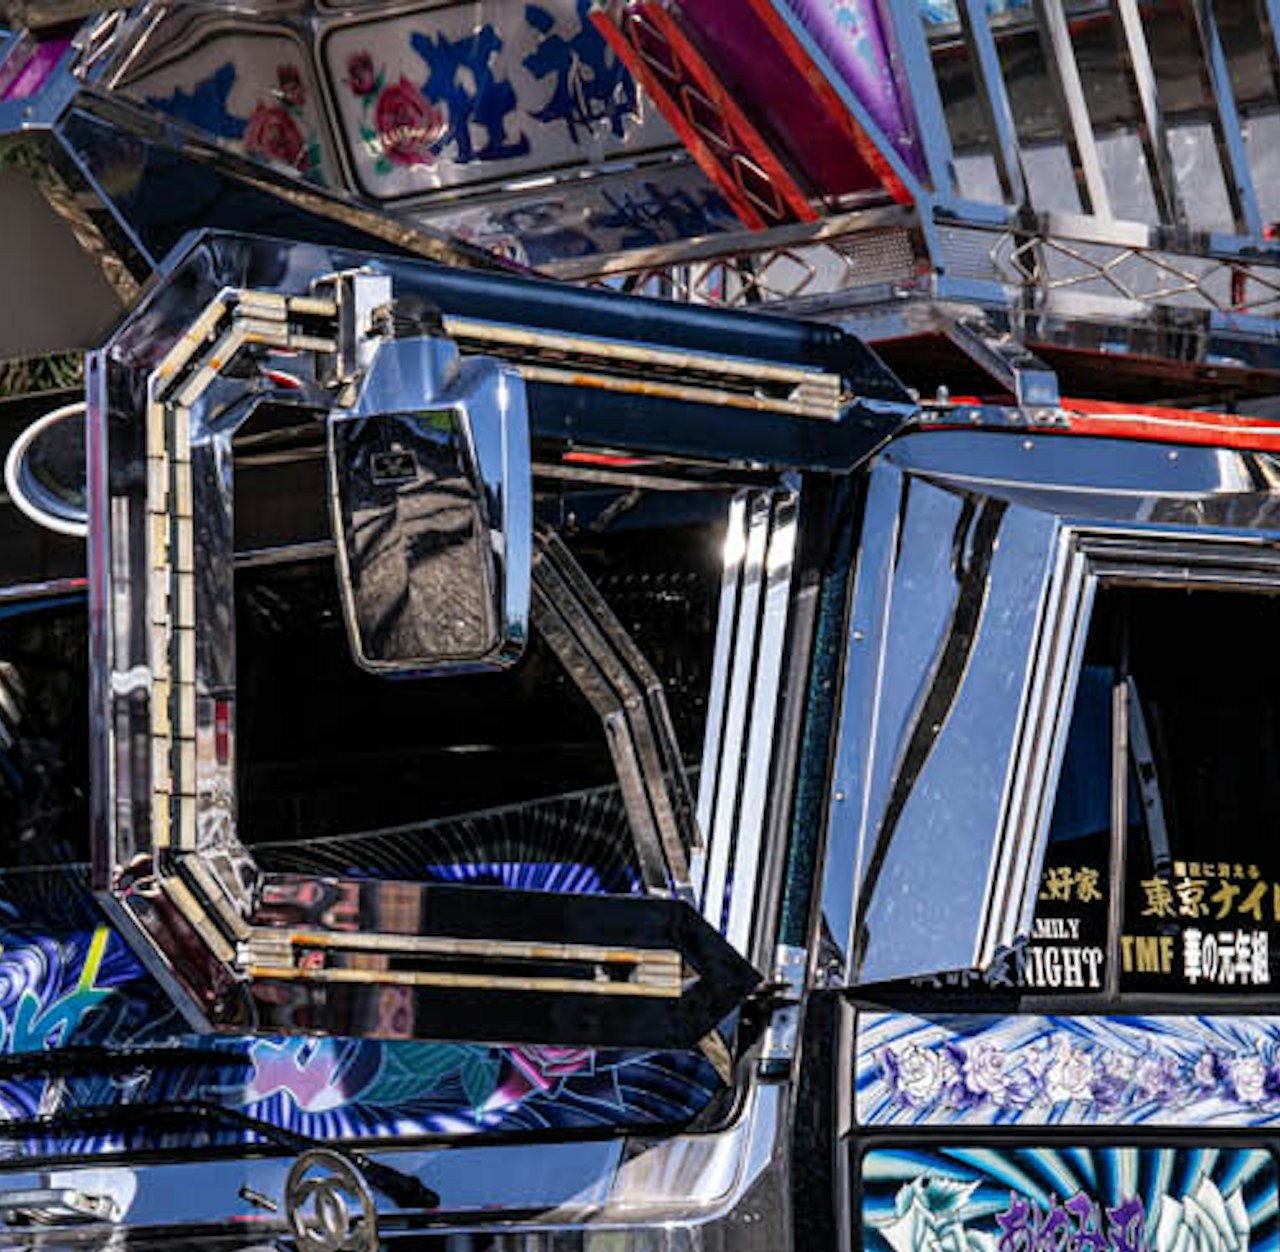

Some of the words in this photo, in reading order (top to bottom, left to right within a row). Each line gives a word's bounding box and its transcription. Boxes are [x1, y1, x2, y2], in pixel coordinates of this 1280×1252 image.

[1038, 865, 1104, 904] 好家
[1032, 917, 1082, 940] MILY
[1120, 935, 1175, 973] TMF
